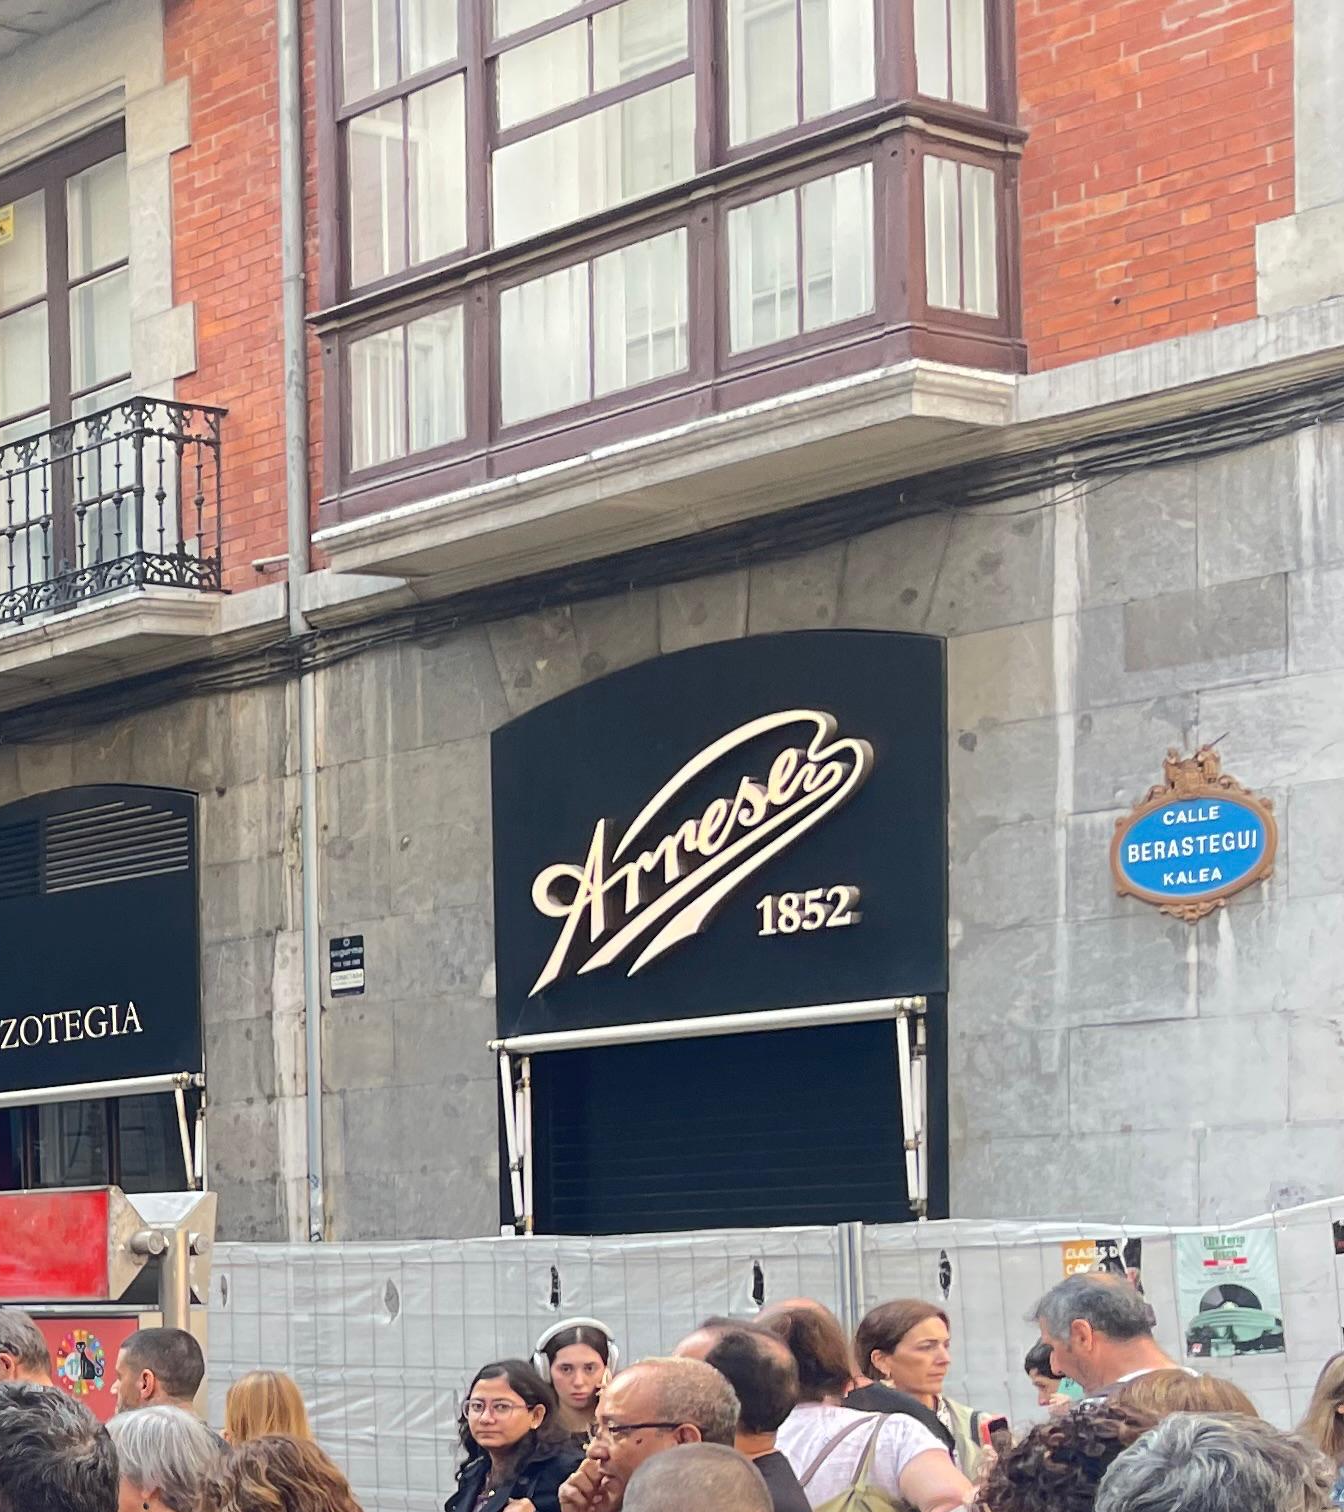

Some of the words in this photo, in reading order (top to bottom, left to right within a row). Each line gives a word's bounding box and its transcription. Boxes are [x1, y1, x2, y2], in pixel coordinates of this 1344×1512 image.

[1163, 806, 1221, 826] CALLE
[1128, 830, 1257, 863] BERASTEGUI
[1163, 867, 1222, 886] KALEA
[756, 886, 855, 937] 1852
